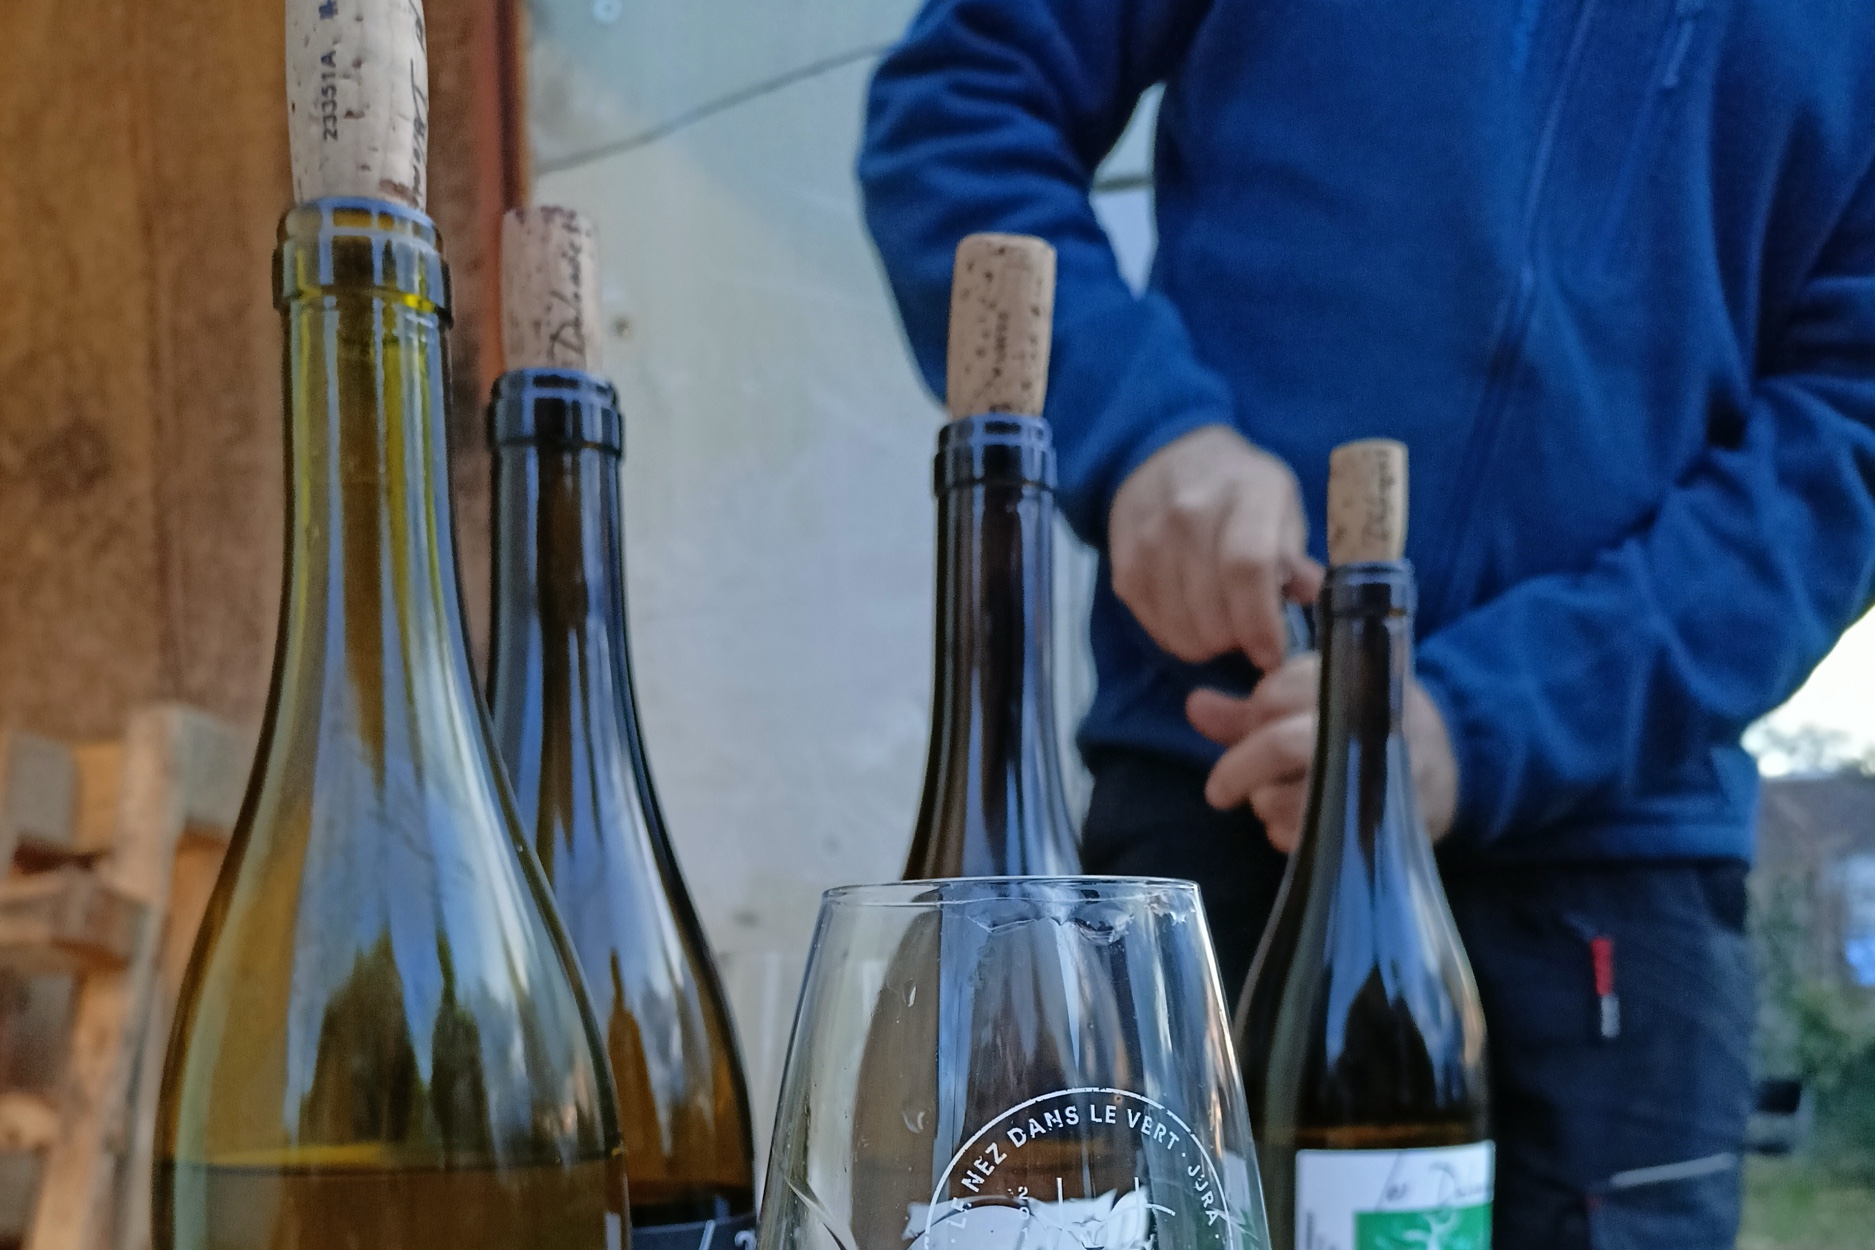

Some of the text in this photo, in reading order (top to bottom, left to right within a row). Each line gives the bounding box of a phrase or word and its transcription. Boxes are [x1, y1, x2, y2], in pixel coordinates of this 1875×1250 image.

[319, 51, 339, 143] 23351A
[961, 1141, 1008, 1194] NEZ
[1006, 1105, 1081, 1148] DANS
[1089, 1103, 1117, 1125] LE
[1127, 1107, 1181, 1150] VERT
[1186, 1163, 1221, 1228] JURA
